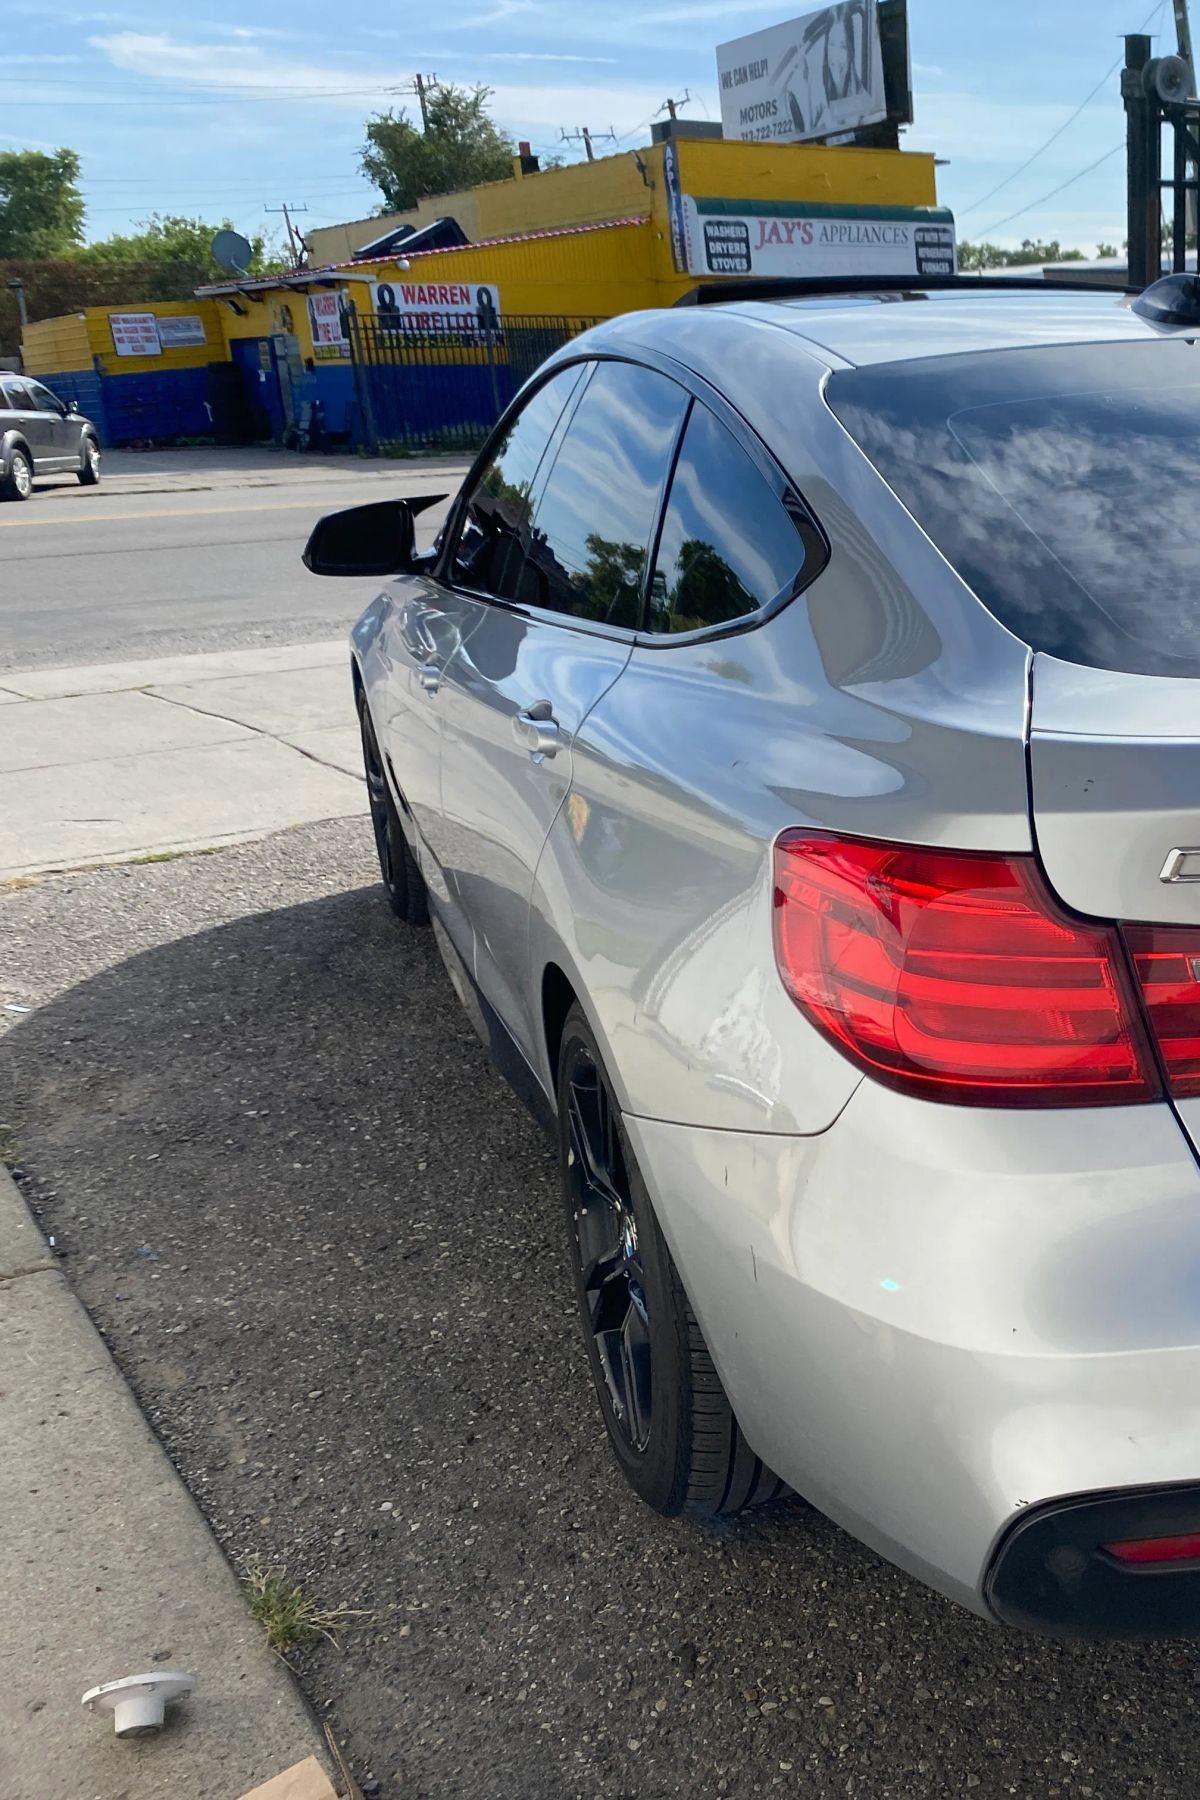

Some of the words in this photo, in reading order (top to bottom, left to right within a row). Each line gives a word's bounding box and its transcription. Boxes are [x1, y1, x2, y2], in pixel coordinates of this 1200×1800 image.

[721, 71, 733, 90] WE
[733, 65, 748, 86] CAN
[740, 99, 778, 126] MOTORS
[705, 225, 747, 238] WASHERS
[754, 220, 814, 250] JAY'S
[818, 223, 909, 244] APPLIANCES
[709, 241, 747, 254] DRYERS
[712, 257, 748, 271] STOVES
[401, 284, 472, 305] WARREN
[402, 312, 443, 332] TIRE
